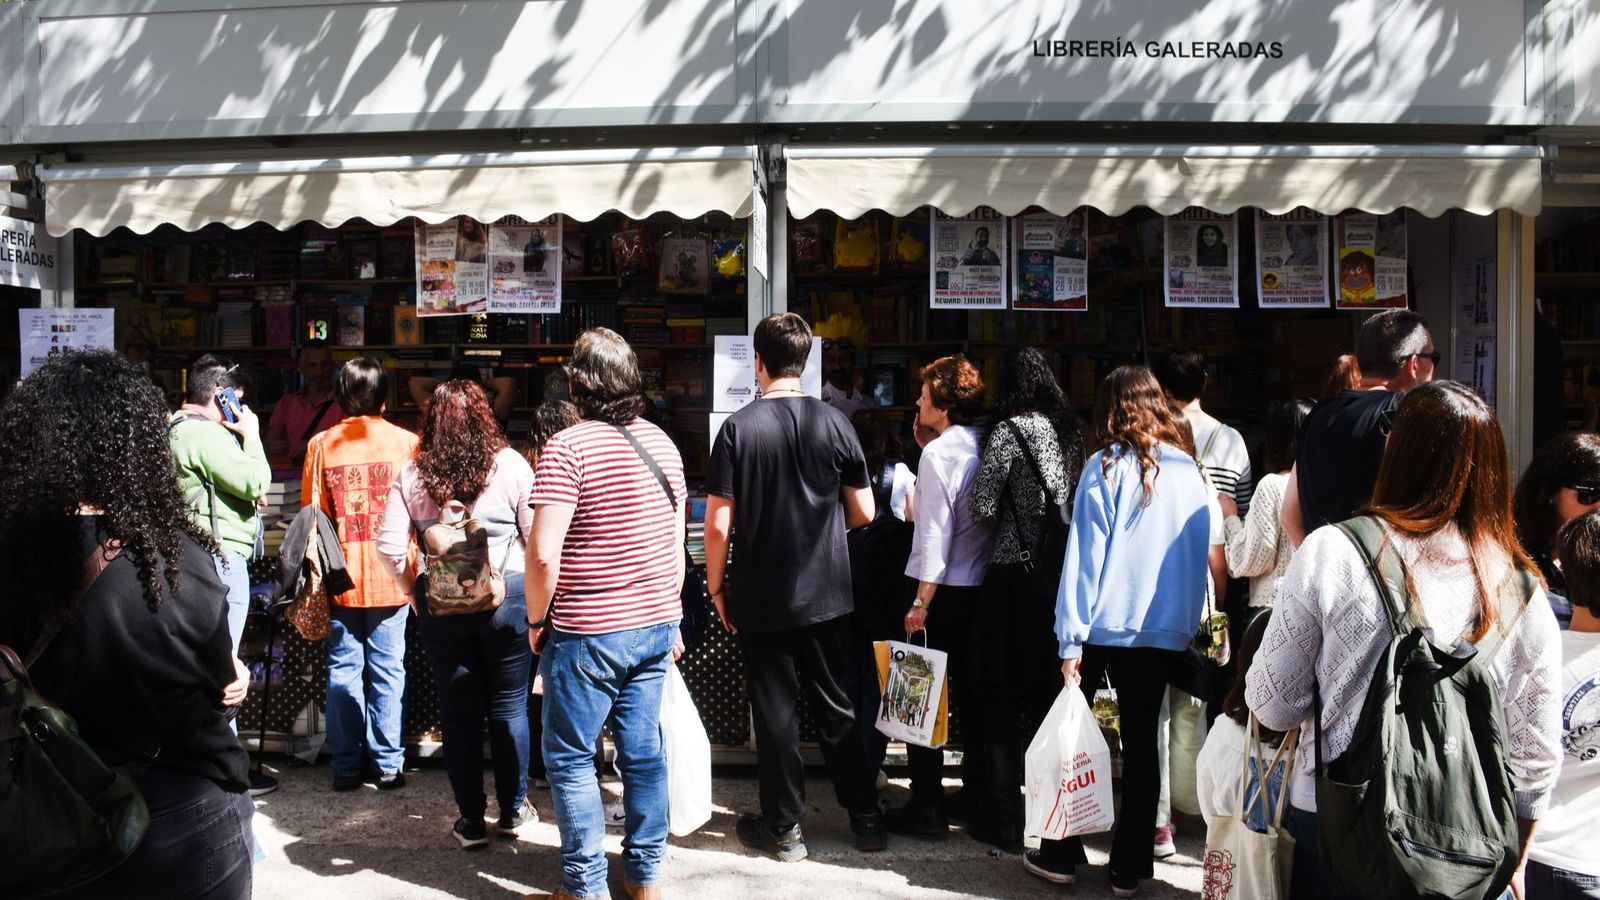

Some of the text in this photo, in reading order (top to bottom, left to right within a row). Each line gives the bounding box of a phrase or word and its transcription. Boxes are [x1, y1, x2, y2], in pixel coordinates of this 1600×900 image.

[1033, 37, 1284, 59] LIBRERÍA GALERADAS
[1056, 280, 1065, 292] 26
[306, 320, 328, 340] 13
